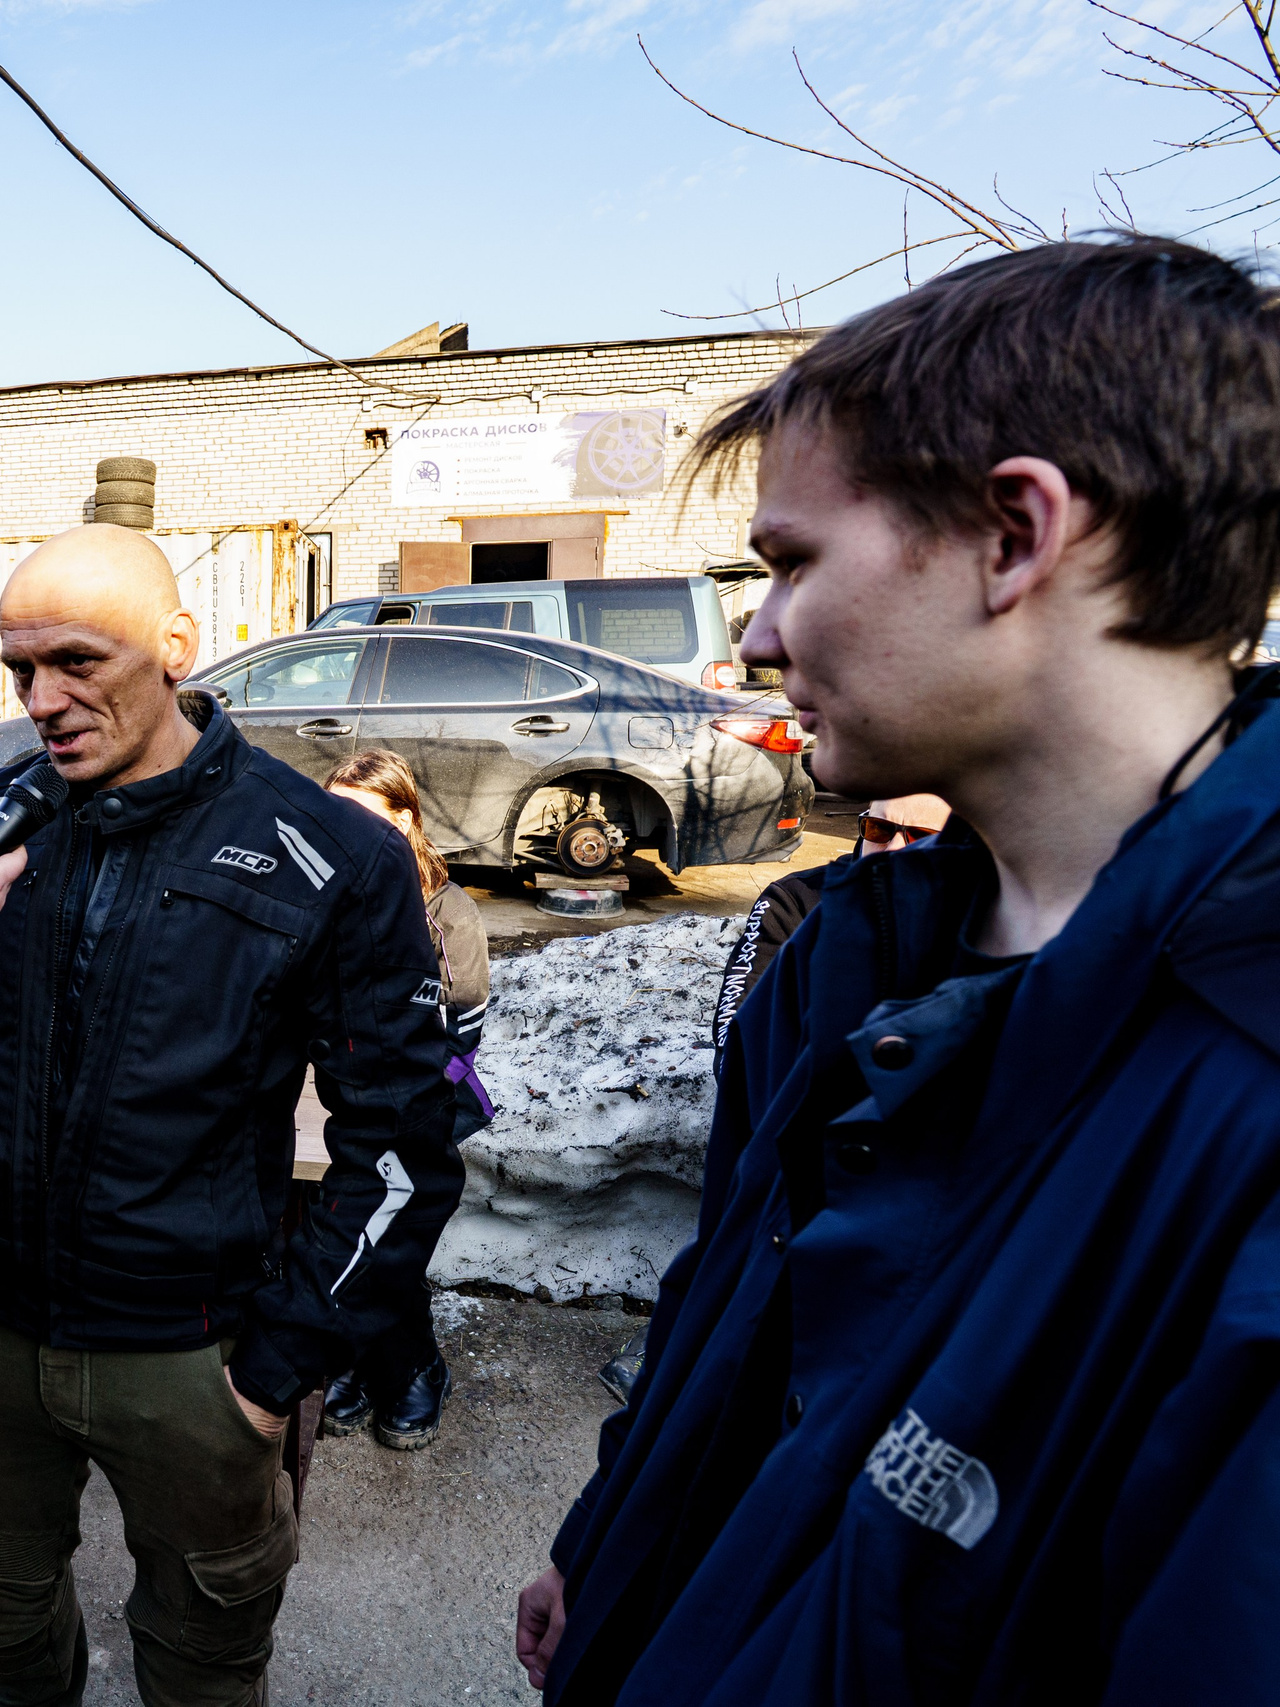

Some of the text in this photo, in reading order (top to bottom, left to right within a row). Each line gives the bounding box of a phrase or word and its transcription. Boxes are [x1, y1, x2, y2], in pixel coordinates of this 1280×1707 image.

[401, 422, 548, 440] ПОКРАСКА ДИСКОВ
[213, 847, 277, 873] MCP
[732, 900, 771, 974] SUPPORT
[899, 1406, 969, 1480] THE
